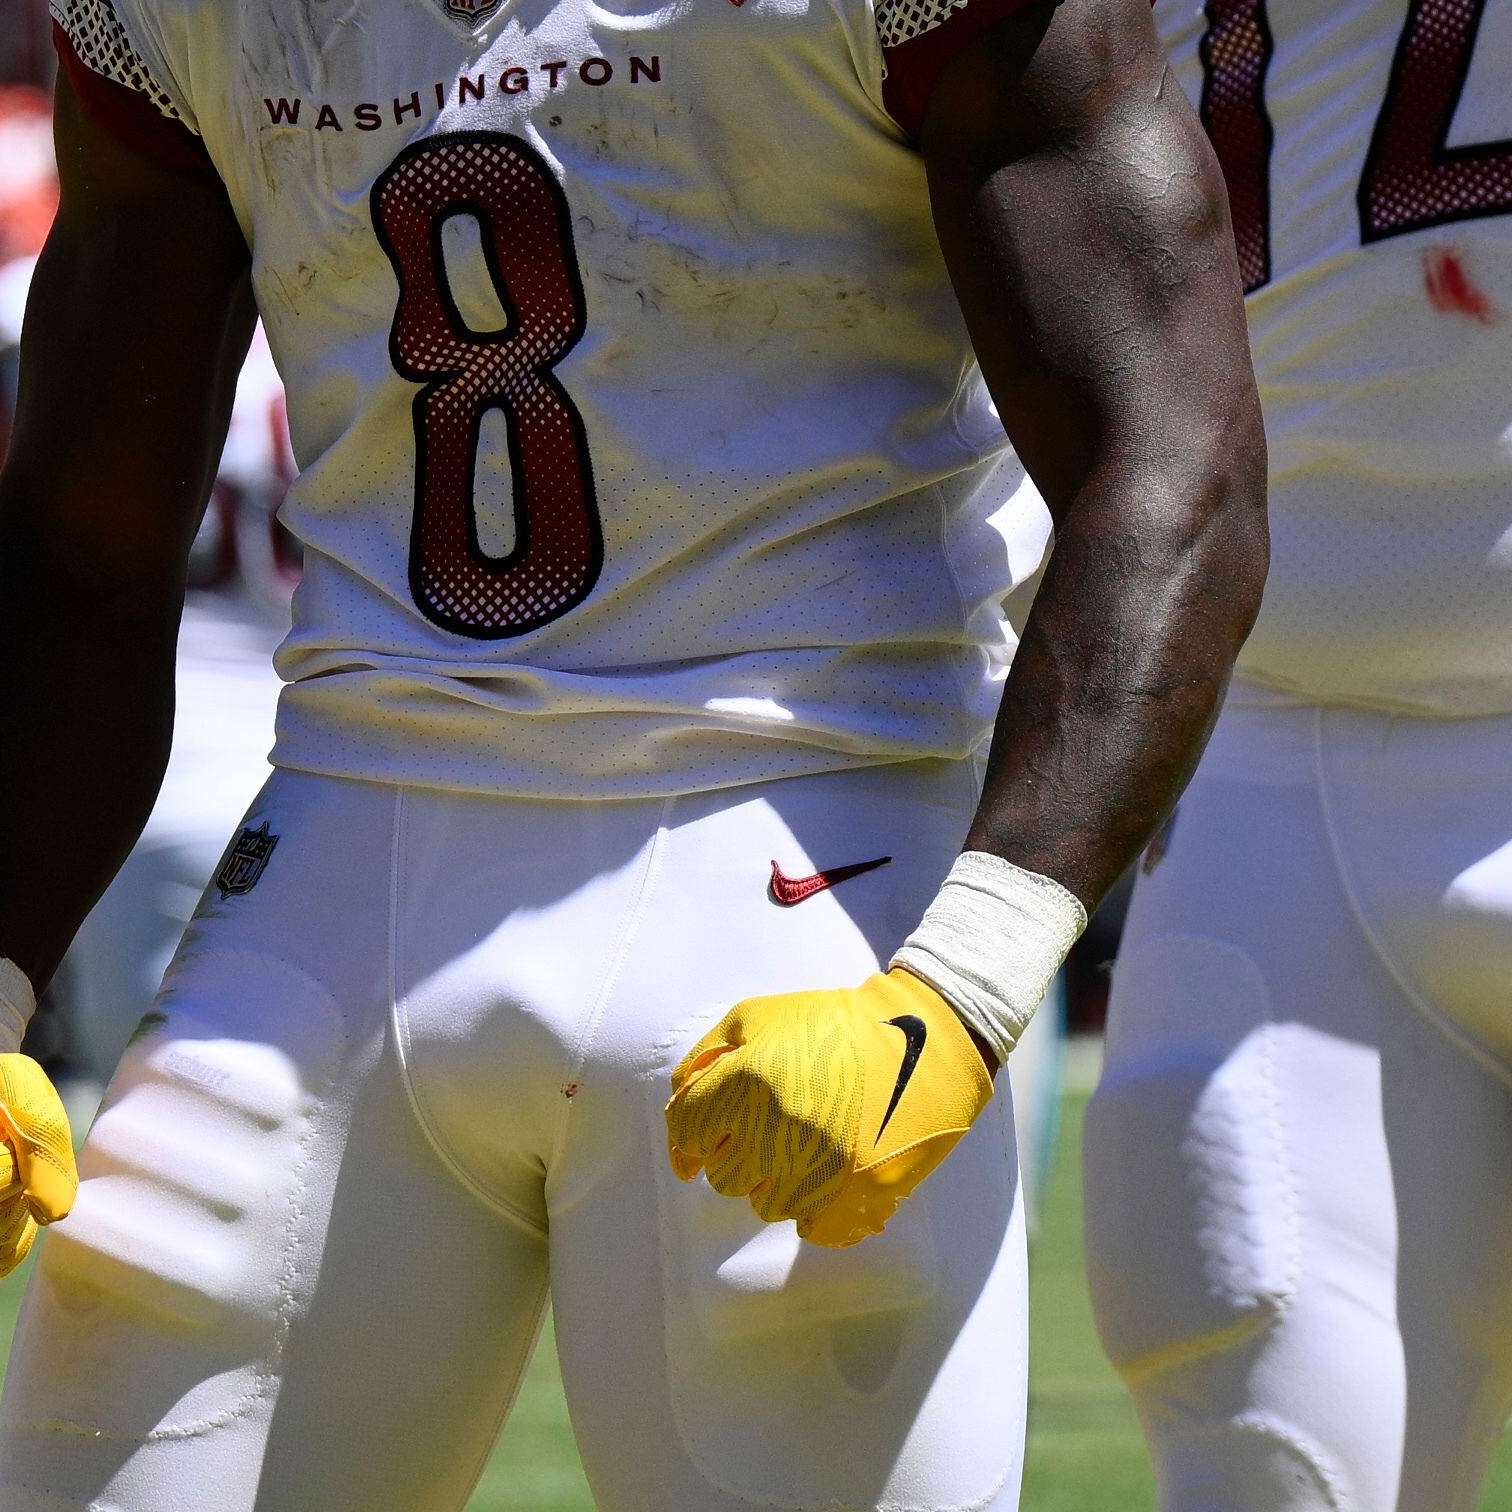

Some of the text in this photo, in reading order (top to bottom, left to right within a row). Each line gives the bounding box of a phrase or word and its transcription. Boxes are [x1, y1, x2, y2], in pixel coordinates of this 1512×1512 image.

[264, 55, 663, 132] WASHINGTON
[370, 129, 605, 639] 8
[222, 853, 262, 887] NFL
